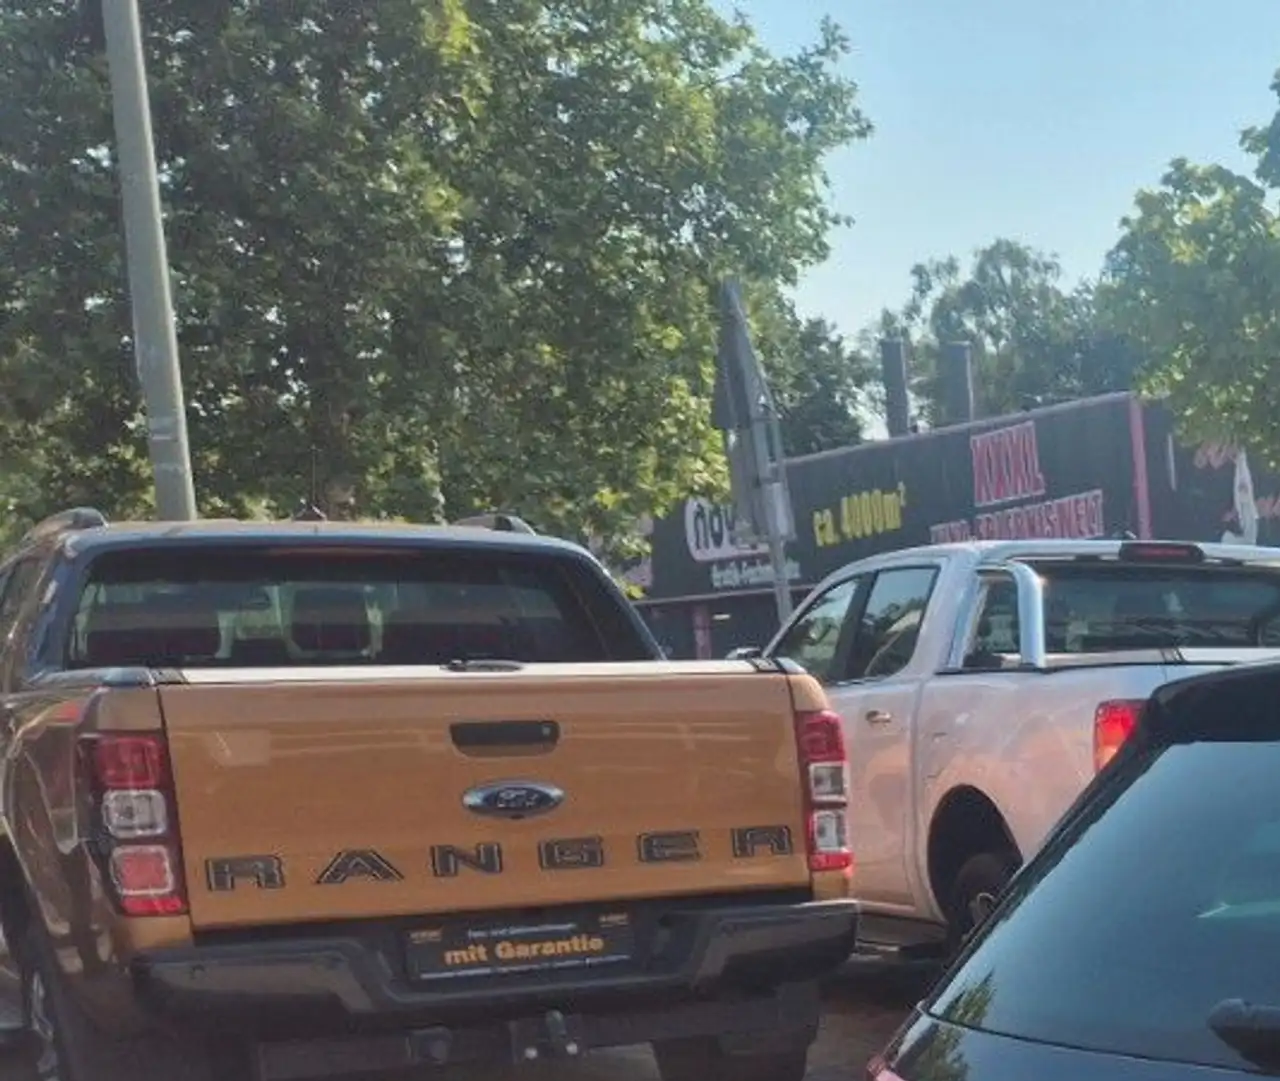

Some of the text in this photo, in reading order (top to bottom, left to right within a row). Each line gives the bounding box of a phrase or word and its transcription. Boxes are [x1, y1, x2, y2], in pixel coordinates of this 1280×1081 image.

[812, 508, 841, 547] ca.
[205, 825, 793, 891] RANGER
[443, 933, 604, 966] mit Garantie
